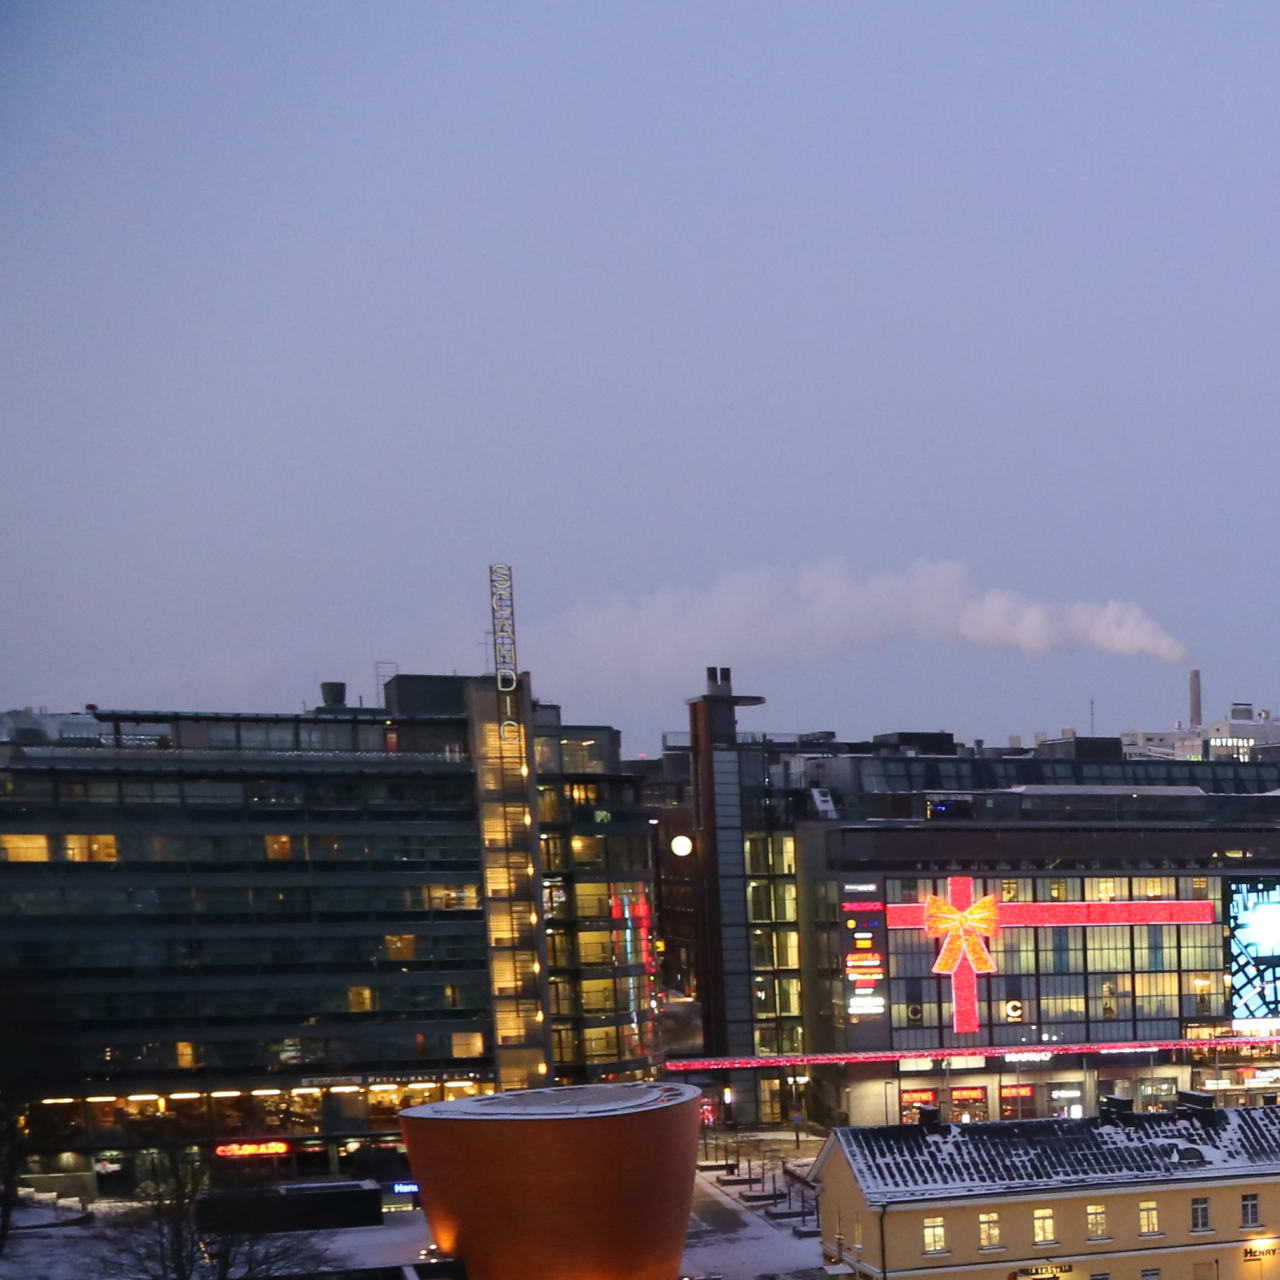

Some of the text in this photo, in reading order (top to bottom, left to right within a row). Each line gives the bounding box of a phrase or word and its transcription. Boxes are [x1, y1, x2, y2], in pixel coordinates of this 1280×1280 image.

[491, 564, 521, 743] SCANDIC
[1006, 1000, 1022, 1017] C
[216, 1142, 287, 1156] COLORADO
